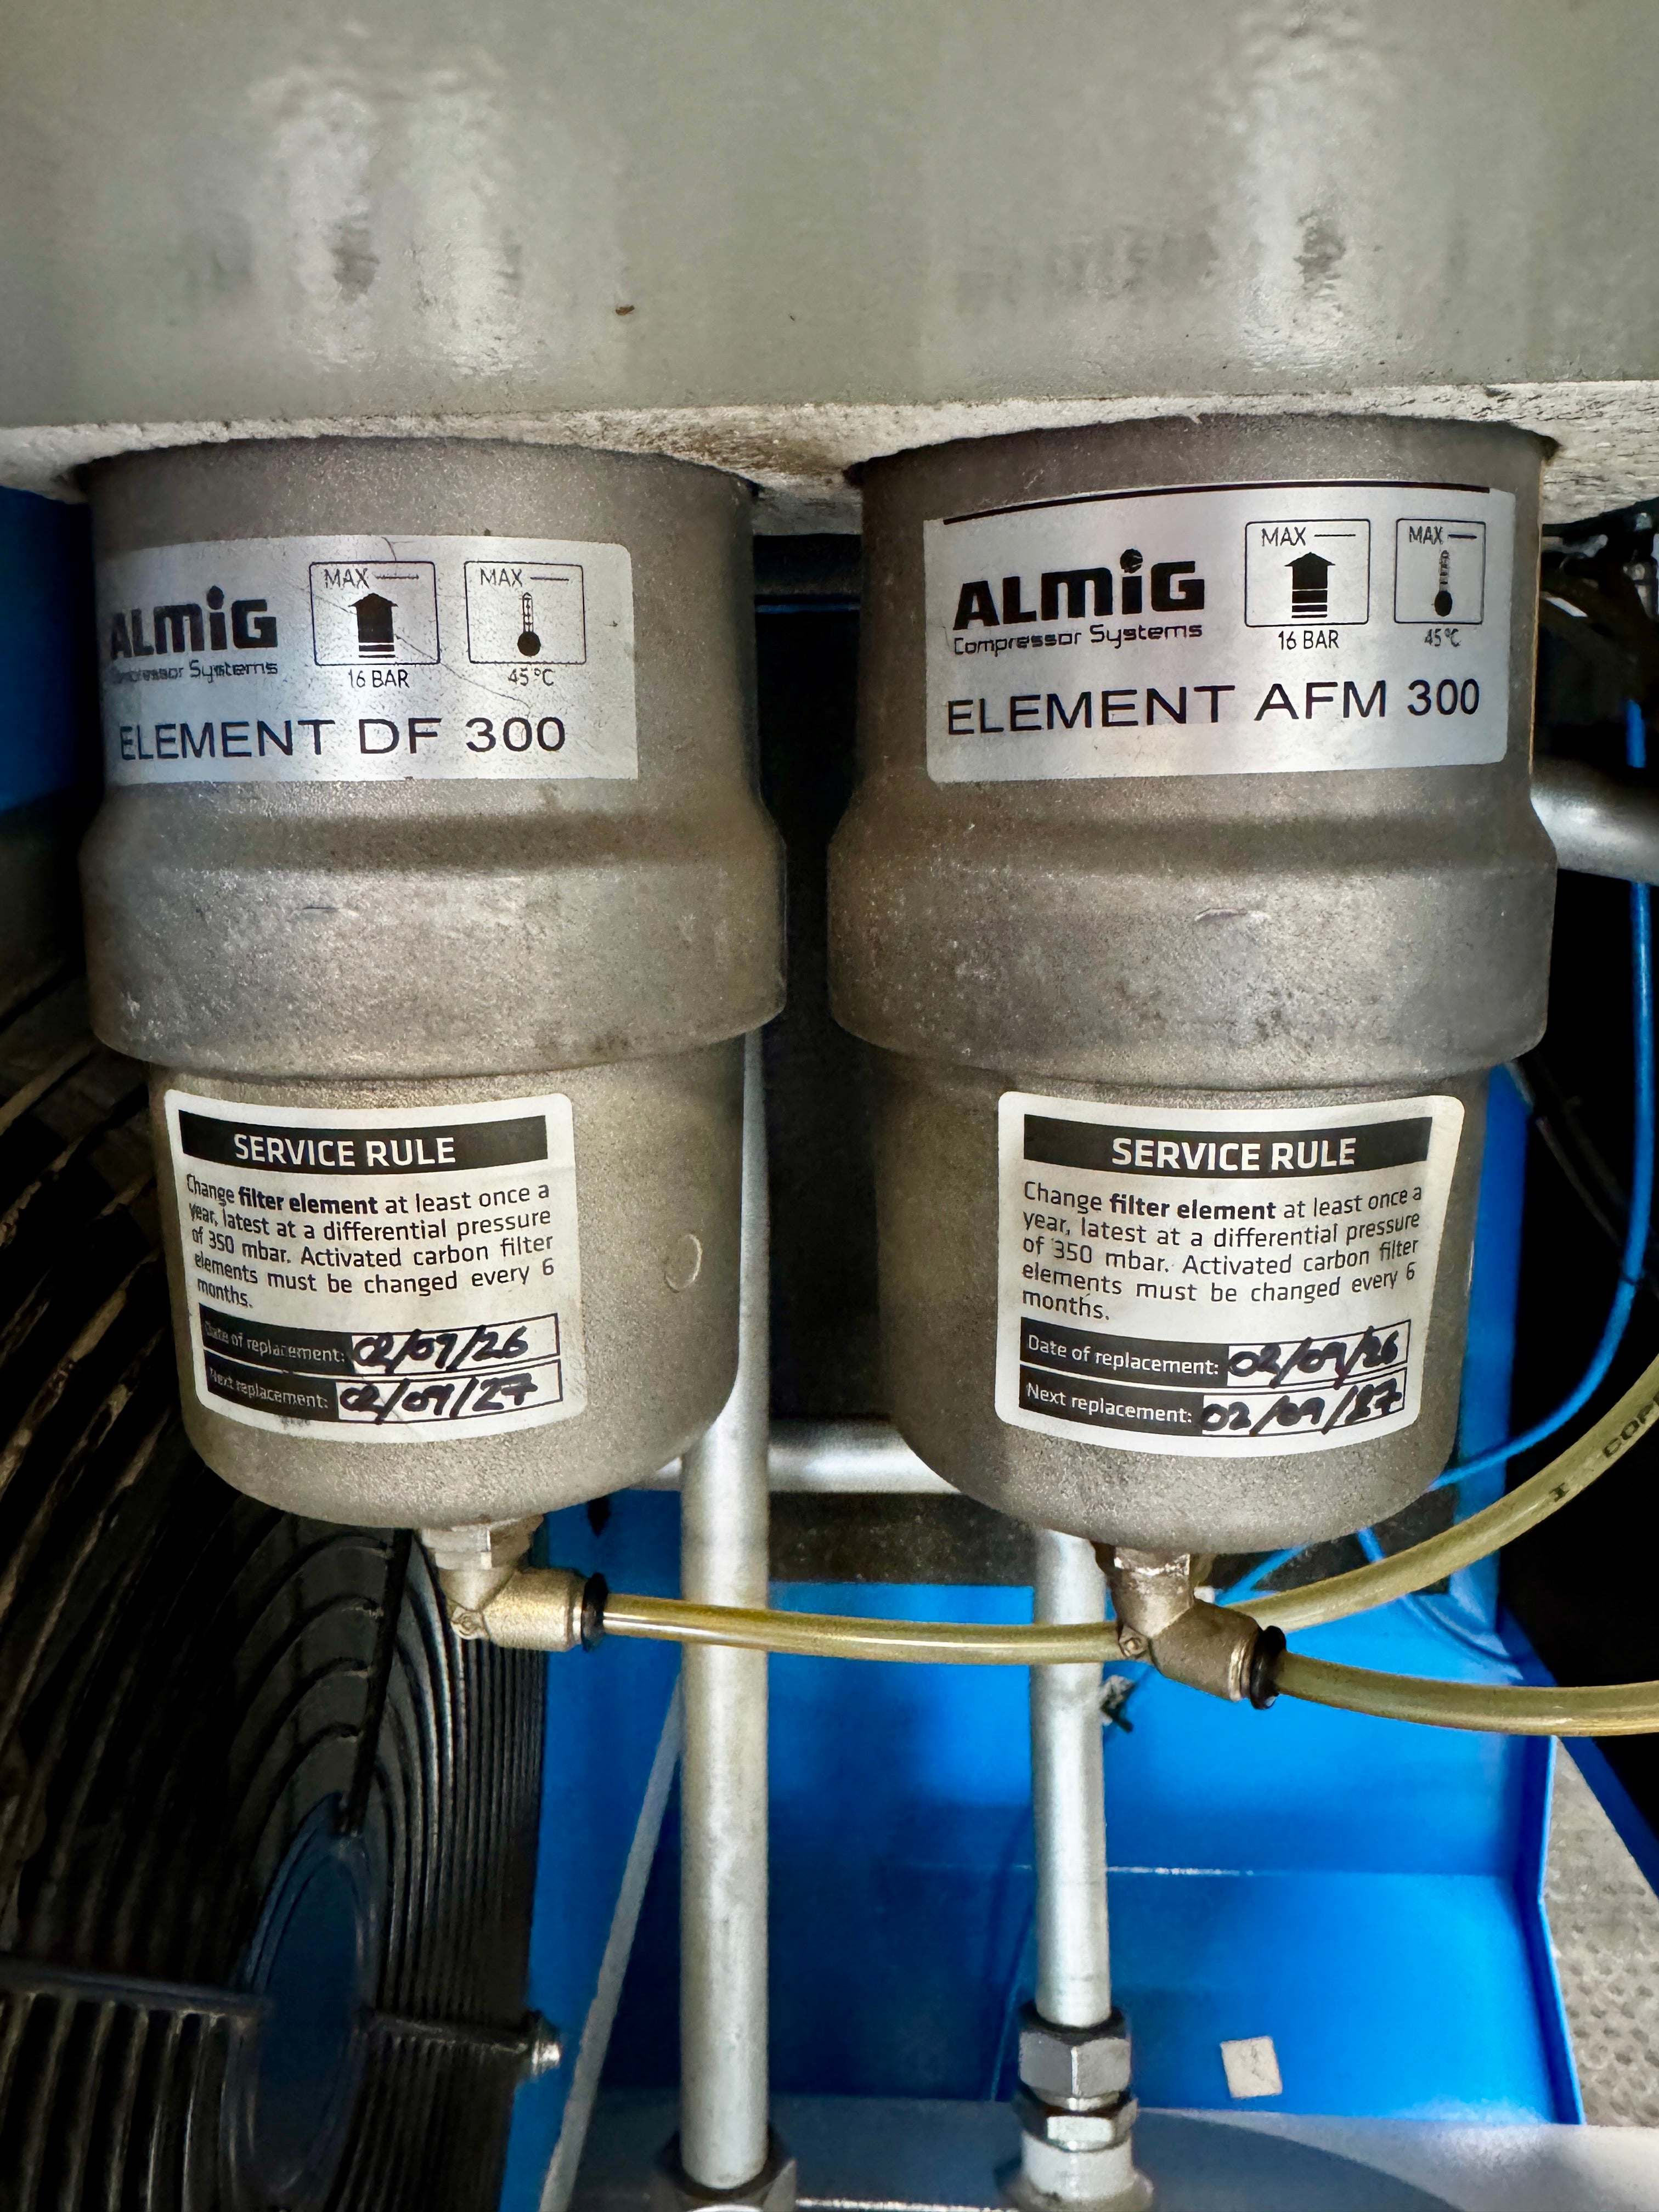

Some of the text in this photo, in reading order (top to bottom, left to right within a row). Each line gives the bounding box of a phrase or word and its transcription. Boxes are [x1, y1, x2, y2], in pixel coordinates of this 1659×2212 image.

[1261, 527, 1306, 546] MAX
[1409, 526, 1443, 545] MAX
[325, 568, 369, 589] MAX
[480, 568, 522, 587] MAX
[955, 624, 1203, 657] Compressor Systems
[1278, 630, 1339, 650] 16 BAR
[189, 659, 278, 684] Systems
[348, 669, 409, 689] 16 BAR
[948, 679, 1480, 735] ELEMENT AFM 300
[120, 717, 566, 760] ELEMENT DF 300
[234, 1133, 456, 1167] SERVICE RULE
[1112, 1137, 1357, 1171] SERVICE RULE
[187, 1173, 549, 1214] Change filter element at least once a
[1024, 1181, 1421, 1220] Change filter element at least once a
[189, 1202, 551, 1242] year, latest at a differential pressure
[1023, 1210, 1420, 1248] year, latest at a differential pressure
[192, 1226, 554, 1268] of 350 mbar. Activated carbon filter
[1023, 1237, 1419, 1275] of 350 mbar. Activated carbon filter
[194, 1251, 554, 1297] elements must be changed every 6
[1022, 1261, 1415, 1304] elements must be changed every 6
[197, 1277, 253, 1308] months.
[1023, 1289, 1110, 1321] months.
[230, 1332, 244, 1348] of
[246, 1339, 345, 1363] replacement:
[1027, 1334, 1219, 1375] Date of replacement:
[236, 1379, 329, 1409] replacement:
[1026, 1381, 1193, 1424] Next replacement:
